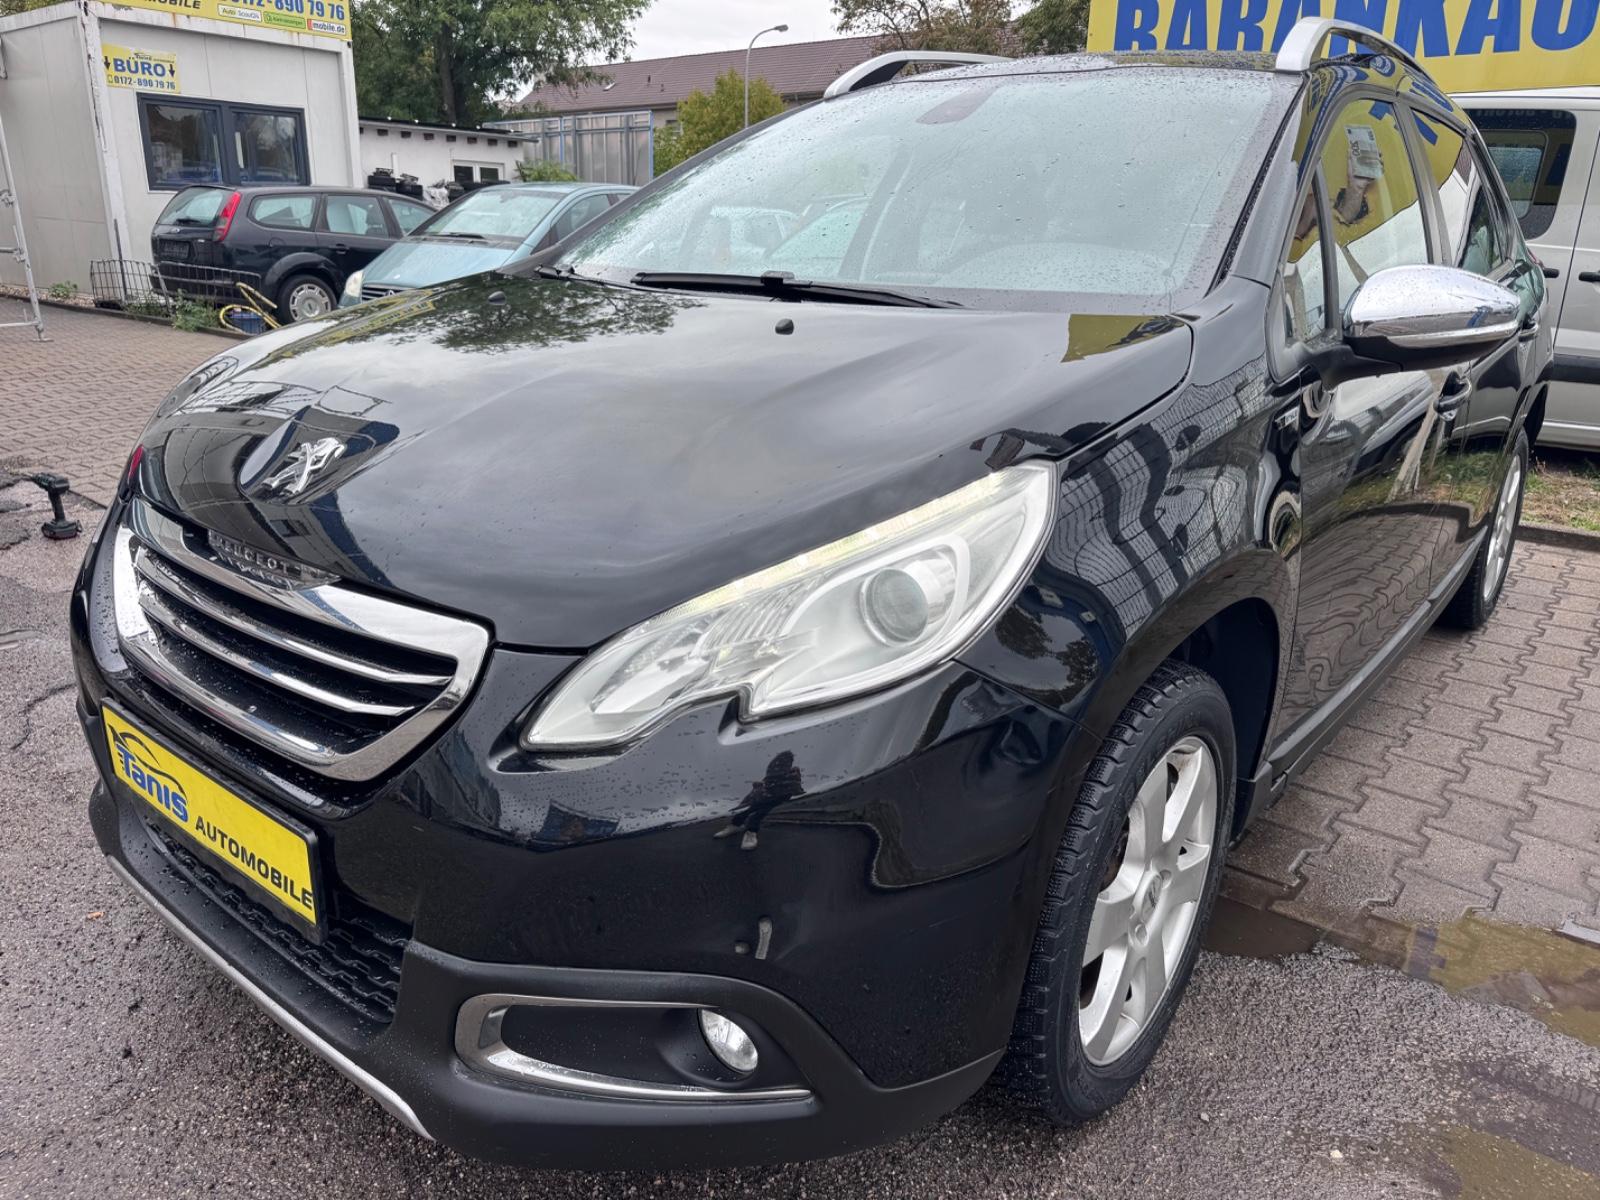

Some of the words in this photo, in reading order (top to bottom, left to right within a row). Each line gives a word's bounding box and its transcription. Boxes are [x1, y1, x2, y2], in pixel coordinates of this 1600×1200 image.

[143, 0, 201, 9] BILE
[306, 0, 325, 17] 79
[328, 3, 345, 20] 76
[313, 22, 345, 34] mobile.de
[1113, 0, 1600, 58] BARNKAU
[113, 57, 166, 77] BÜRO
[155, 80, 165, 88] 79
[166, 81, 176, 90] 76
[116, 744, 189, 823] Tanis
[195, 815, 314, 911] AUTOMOBILE
